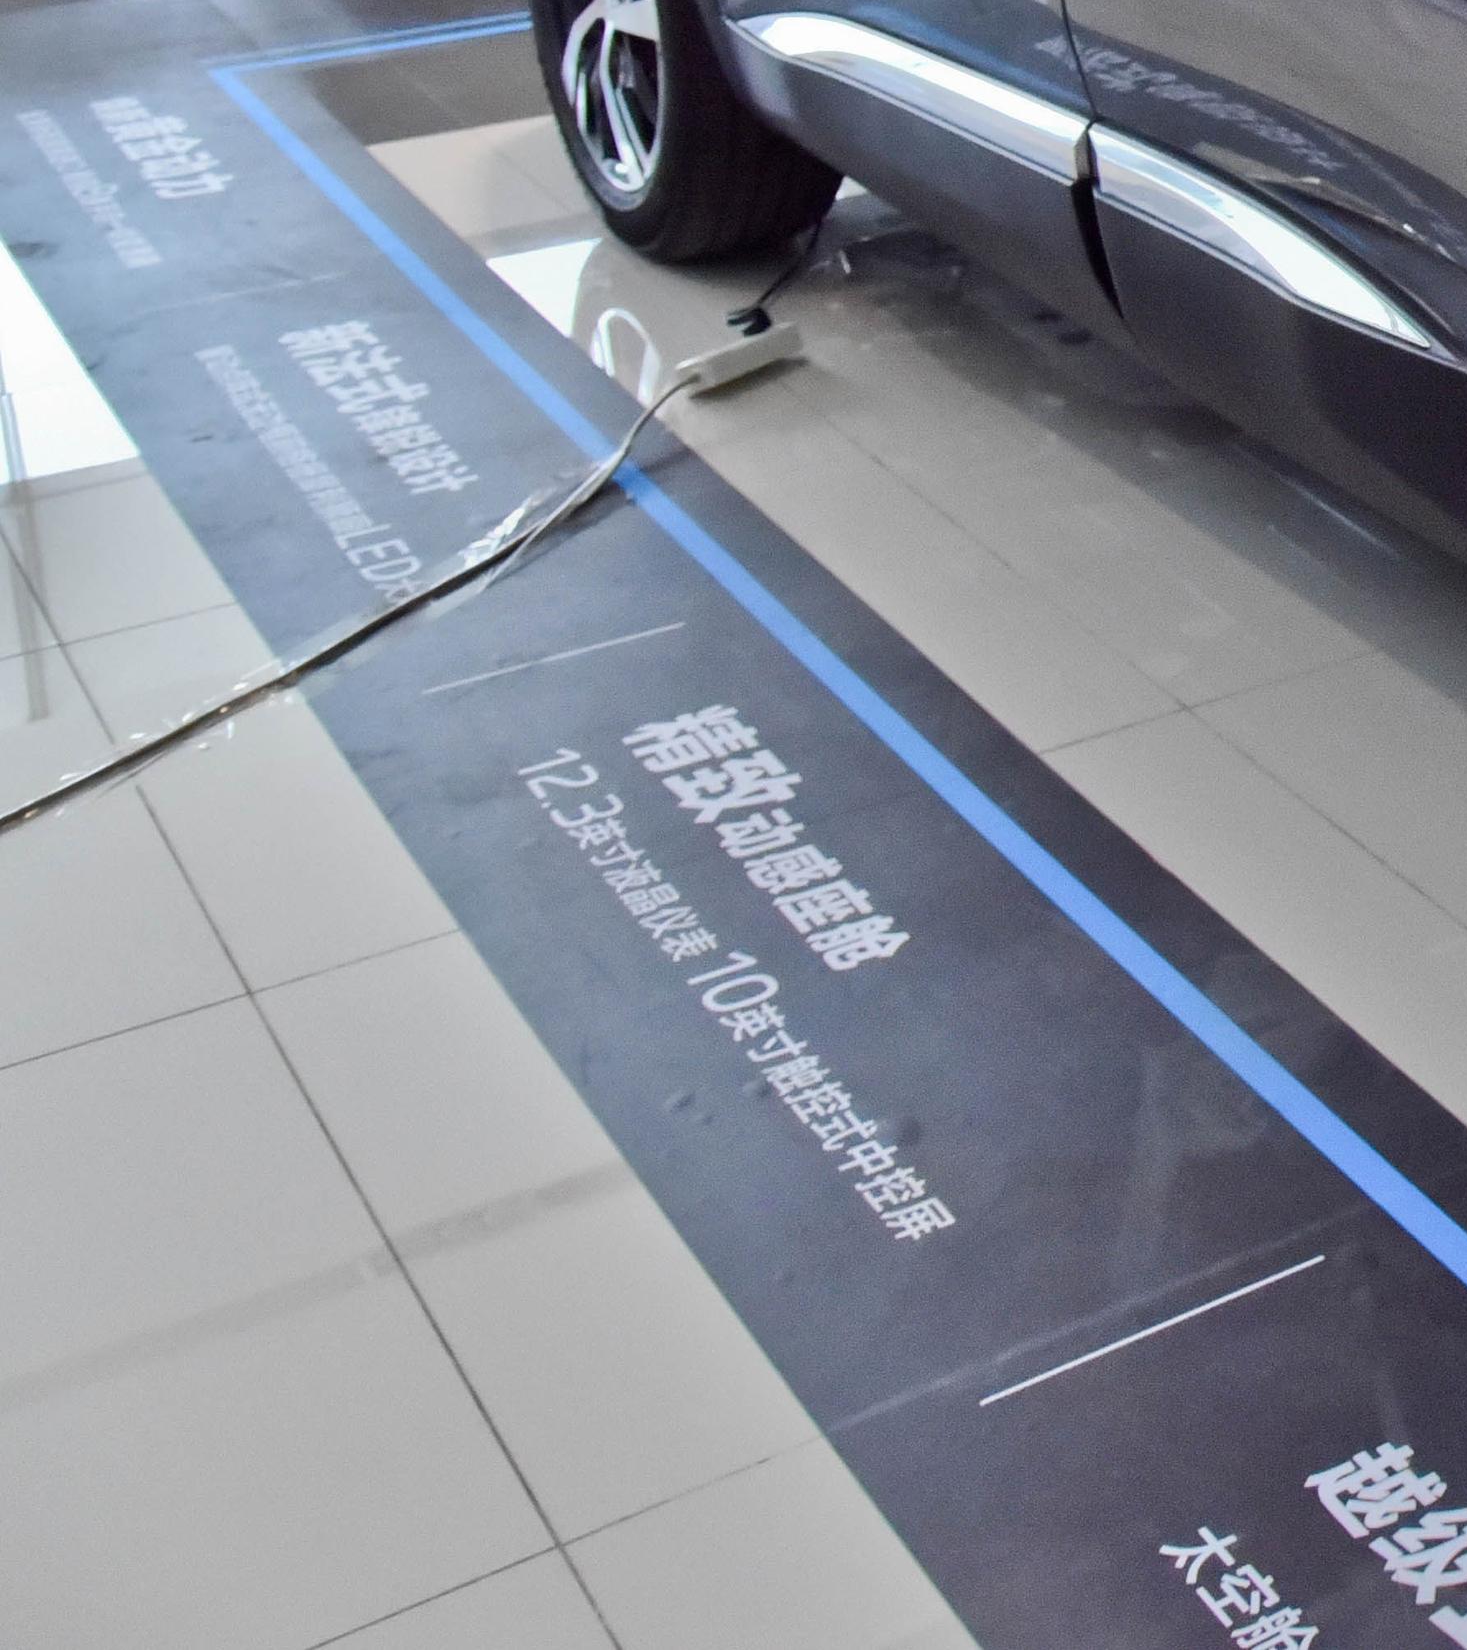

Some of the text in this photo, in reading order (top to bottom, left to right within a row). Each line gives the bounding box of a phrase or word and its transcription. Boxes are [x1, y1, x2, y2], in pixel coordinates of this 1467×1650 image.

[517, 748, 956, 1241] 12.3英寸液晶仪表 10英寸触控式中控屏
[621, 704, 911, 971] 精致动感座舱
